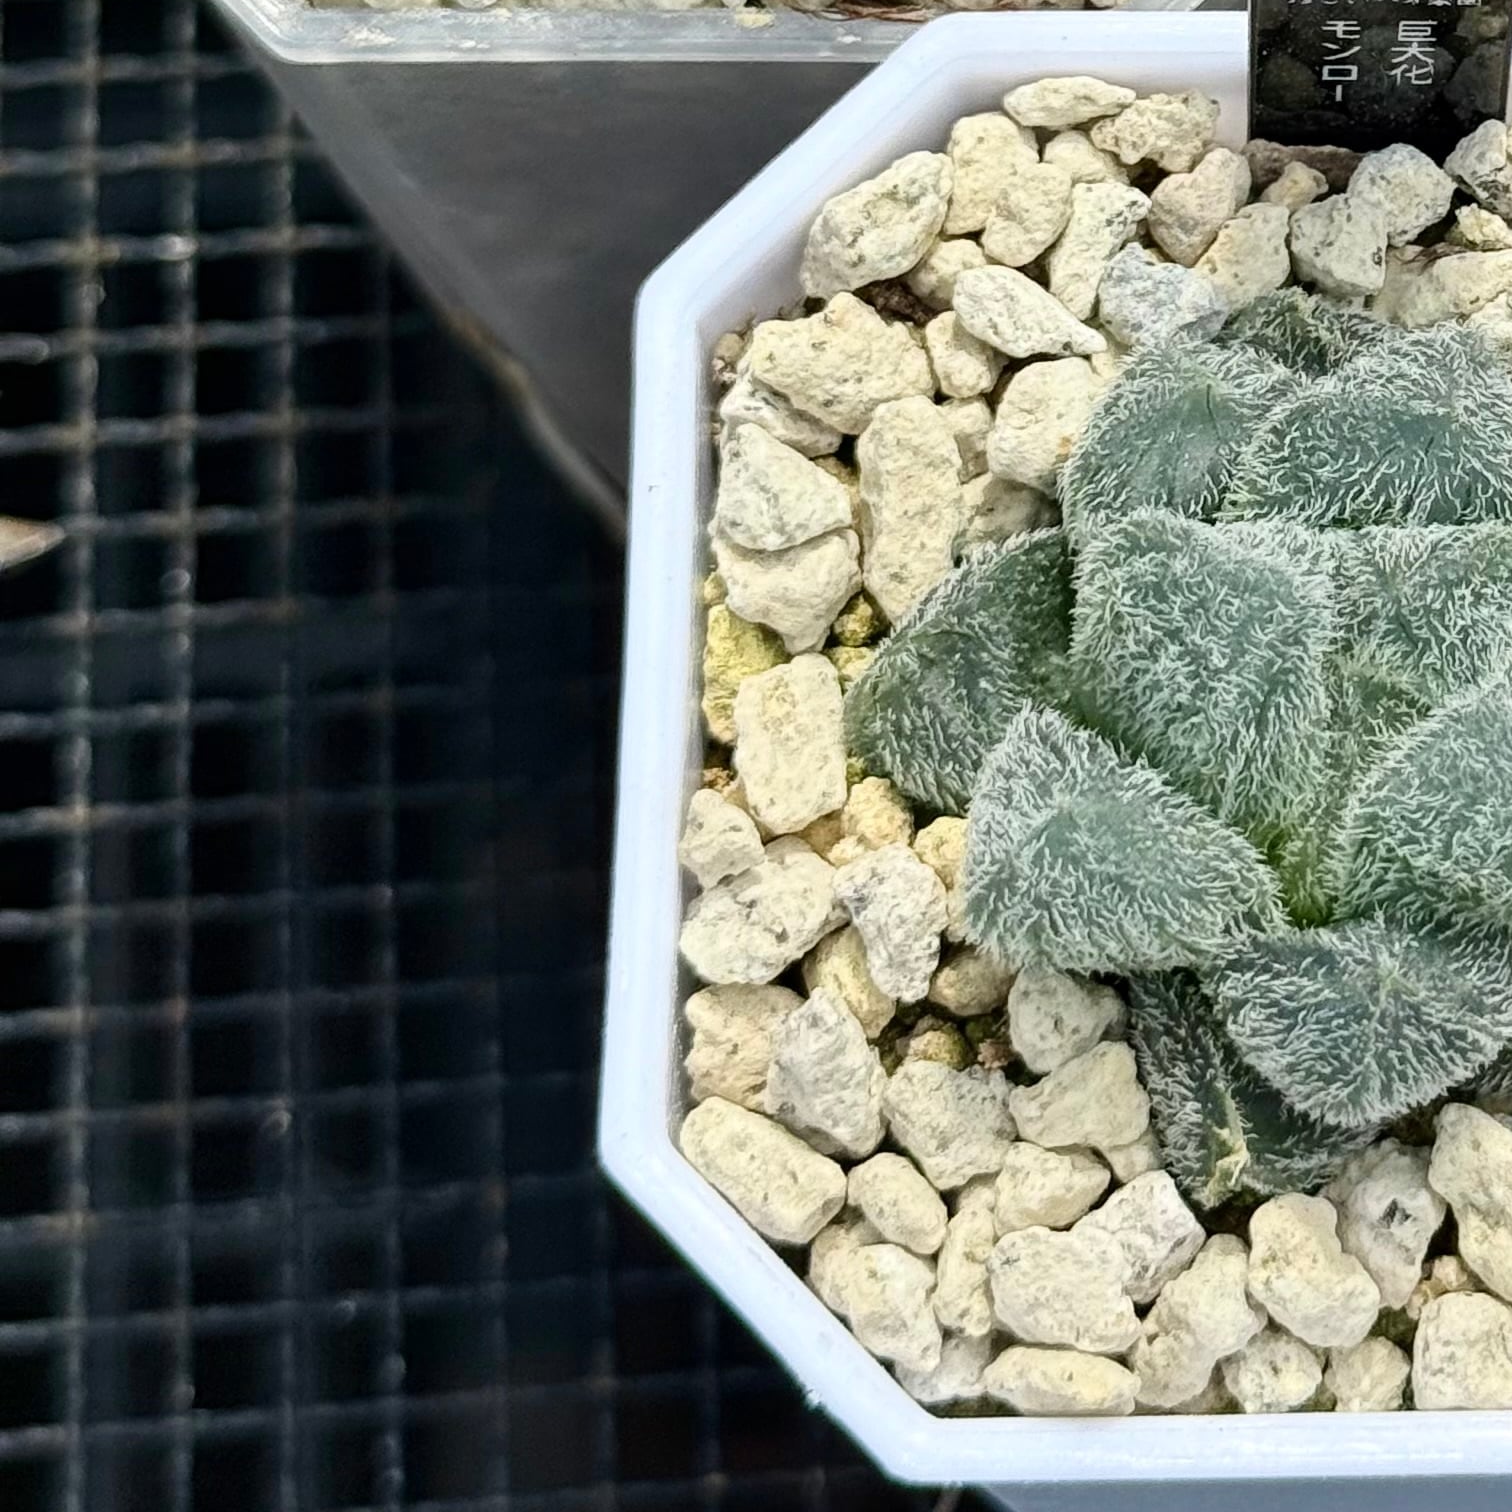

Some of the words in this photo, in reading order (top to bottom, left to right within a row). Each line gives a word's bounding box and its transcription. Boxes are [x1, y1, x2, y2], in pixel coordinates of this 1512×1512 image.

[1321, 20, 1361, 102] モンロー
[1388, 20, 1437, 85] 巨大化
